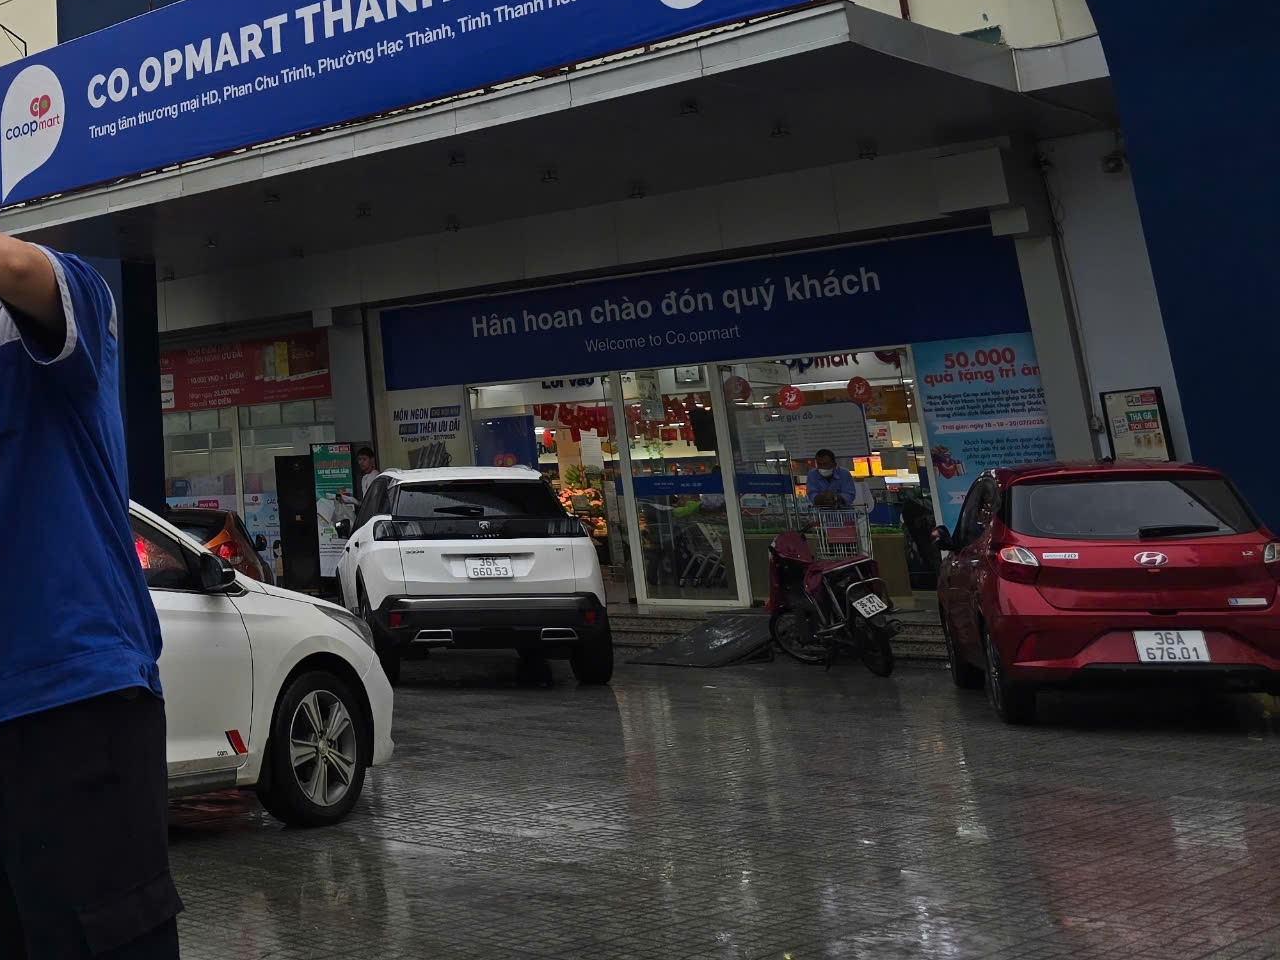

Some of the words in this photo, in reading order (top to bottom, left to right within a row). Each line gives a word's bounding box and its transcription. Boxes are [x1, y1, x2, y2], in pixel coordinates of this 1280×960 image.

[87, 13, 288, 109] CO.OPMART
[89, 122, 117, 139] Trung
[118, 116, 137, 131] tâm
[138, 102, 179, 125] thương
[180, 94, 200, 114] mại
[201, 89, 222, 107] HD,
[223, 83, 253, 101] Phan
[254, 75, 279, 93] Chu
[280, 64, 316, 85] Trinh,
[318, 41, 374, 75] Phường
[376, 36, 404, 61] Hạc
[405, 21, 456, 51] Thành,
[471, 314, 518, 339] Hân
[523, 307, 583, 332] hoan
[589, 295, 655, 326] chào
[660, 289, 715, 317] đón
[722, 278, 777, 314] quý
[783, 266, 881, 302] khách
[584, 330, 645, 353] Welcome
[648, 332, 662, 347] to
[665, 325, 741, 348] Co.opmart
[944, 347, 1016, 370] 50.000
[924, 371, 954, 387] quà
[958, 369, 995, 384] tặng
[998, 365, 1017, 378] tri
[393, 408, 409, 422] MÓN
[410, 407, 429, 420] NGON
[420, 420, 437, 434] THÊM
[438, 420, 448, 433] ƯU
[449, 418, 461, 432] ĐÃI
[480, 557, 499, 567] 36K
[472, 568, 509, 577] 660.53
[1154, 632, 1186, 647] 36A
[1145, 646, 1200, 661] 676.01
